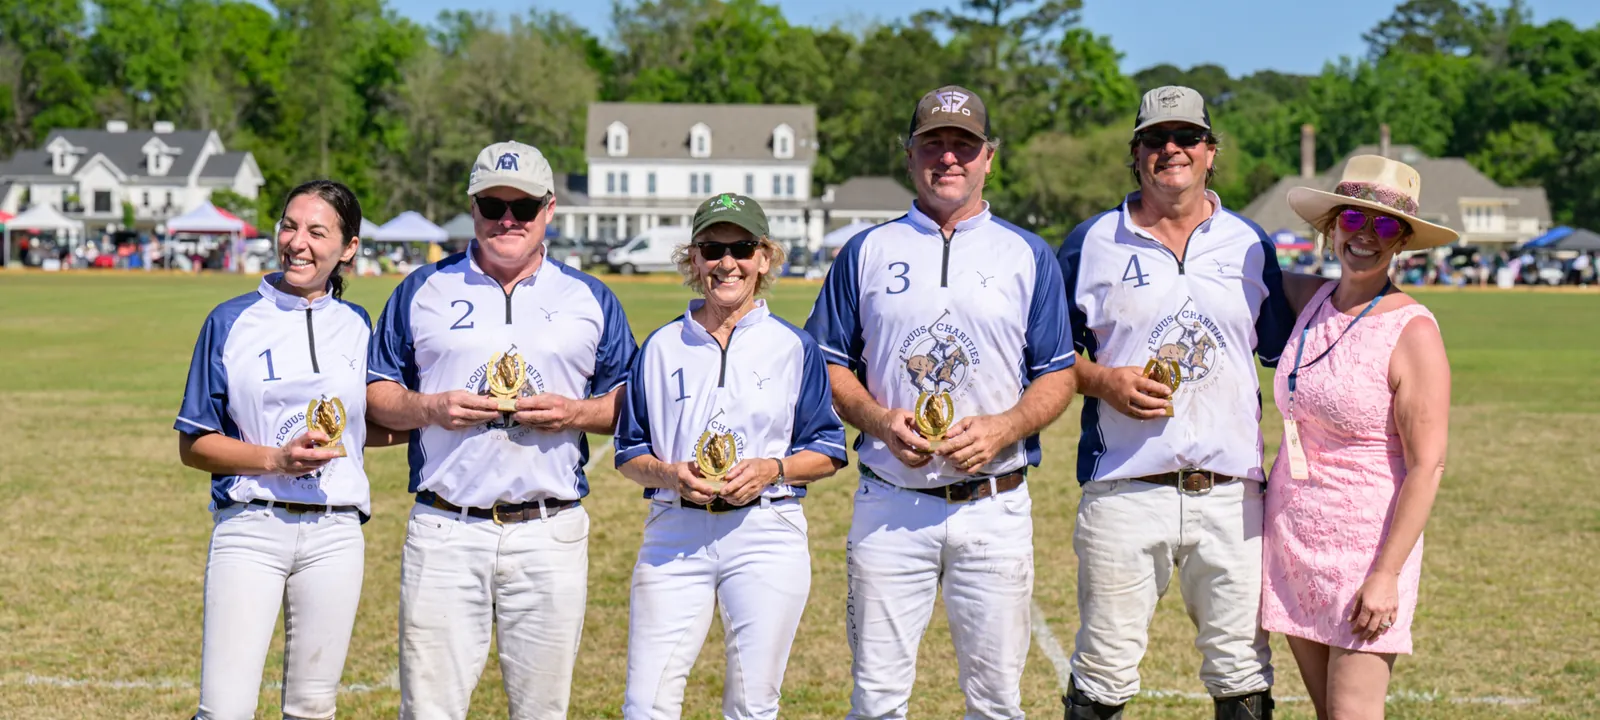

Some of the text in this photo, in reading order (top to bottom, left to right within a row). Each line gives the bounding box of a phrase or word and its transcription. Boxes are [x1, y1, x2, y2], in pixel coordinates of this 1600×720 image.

[932, 105, 971, 117] POLO
[709, 197, 745, 207] POLO
[886, 261, 911, 295] 3
[1122, 253, 1150, 288] 4
[449, 299, 474, 330] 2
[1147, 310, 1227, 349] EQUUS CHARITIES
[900, 322, 981, 366] EQUUS CHARITIES
[258, 348, 282, 382] 1
[465, 361, 490, 391] EQUU
[671, 367, 691, 402] 1
[275, 411, 305, 442] EQUUS
